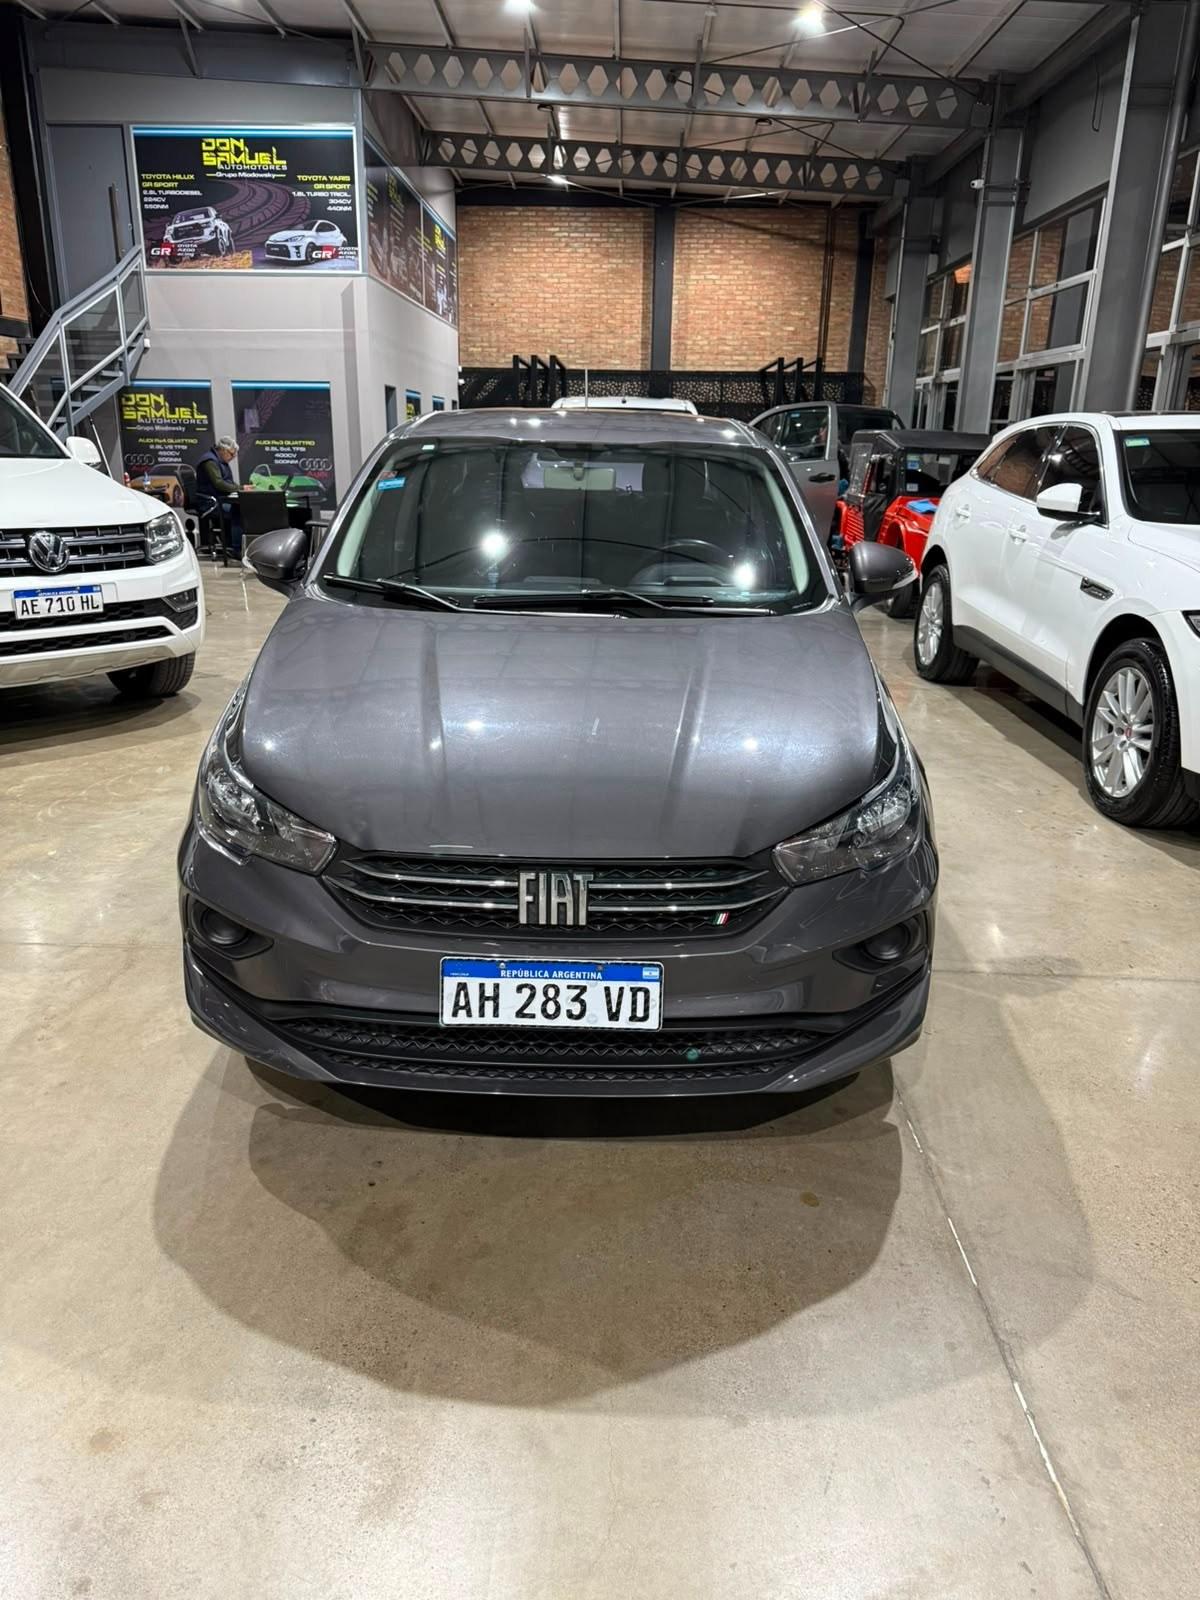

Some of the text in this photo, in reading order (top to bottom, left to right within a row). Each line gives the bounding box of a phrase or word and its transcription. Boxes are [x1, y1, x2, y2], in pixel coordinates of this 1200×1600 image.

[202, 137, 244, 153] DON
[202, 146, 287, 167] SAMUEL
[151, 247, 171, 256] GR
[312, 250, 333, 259] GR
[121, 393, 164, 408] DON
[122, 401, 208, 419] SAMUEL
[21, 595, 100, 616] AE 710 HL
[519, 872, 594, 926] FIAT
[500, 968, 602, 980] REPÚBLICA ARGENTINA
[451, 982, 652, 1023] AH 283 VD
